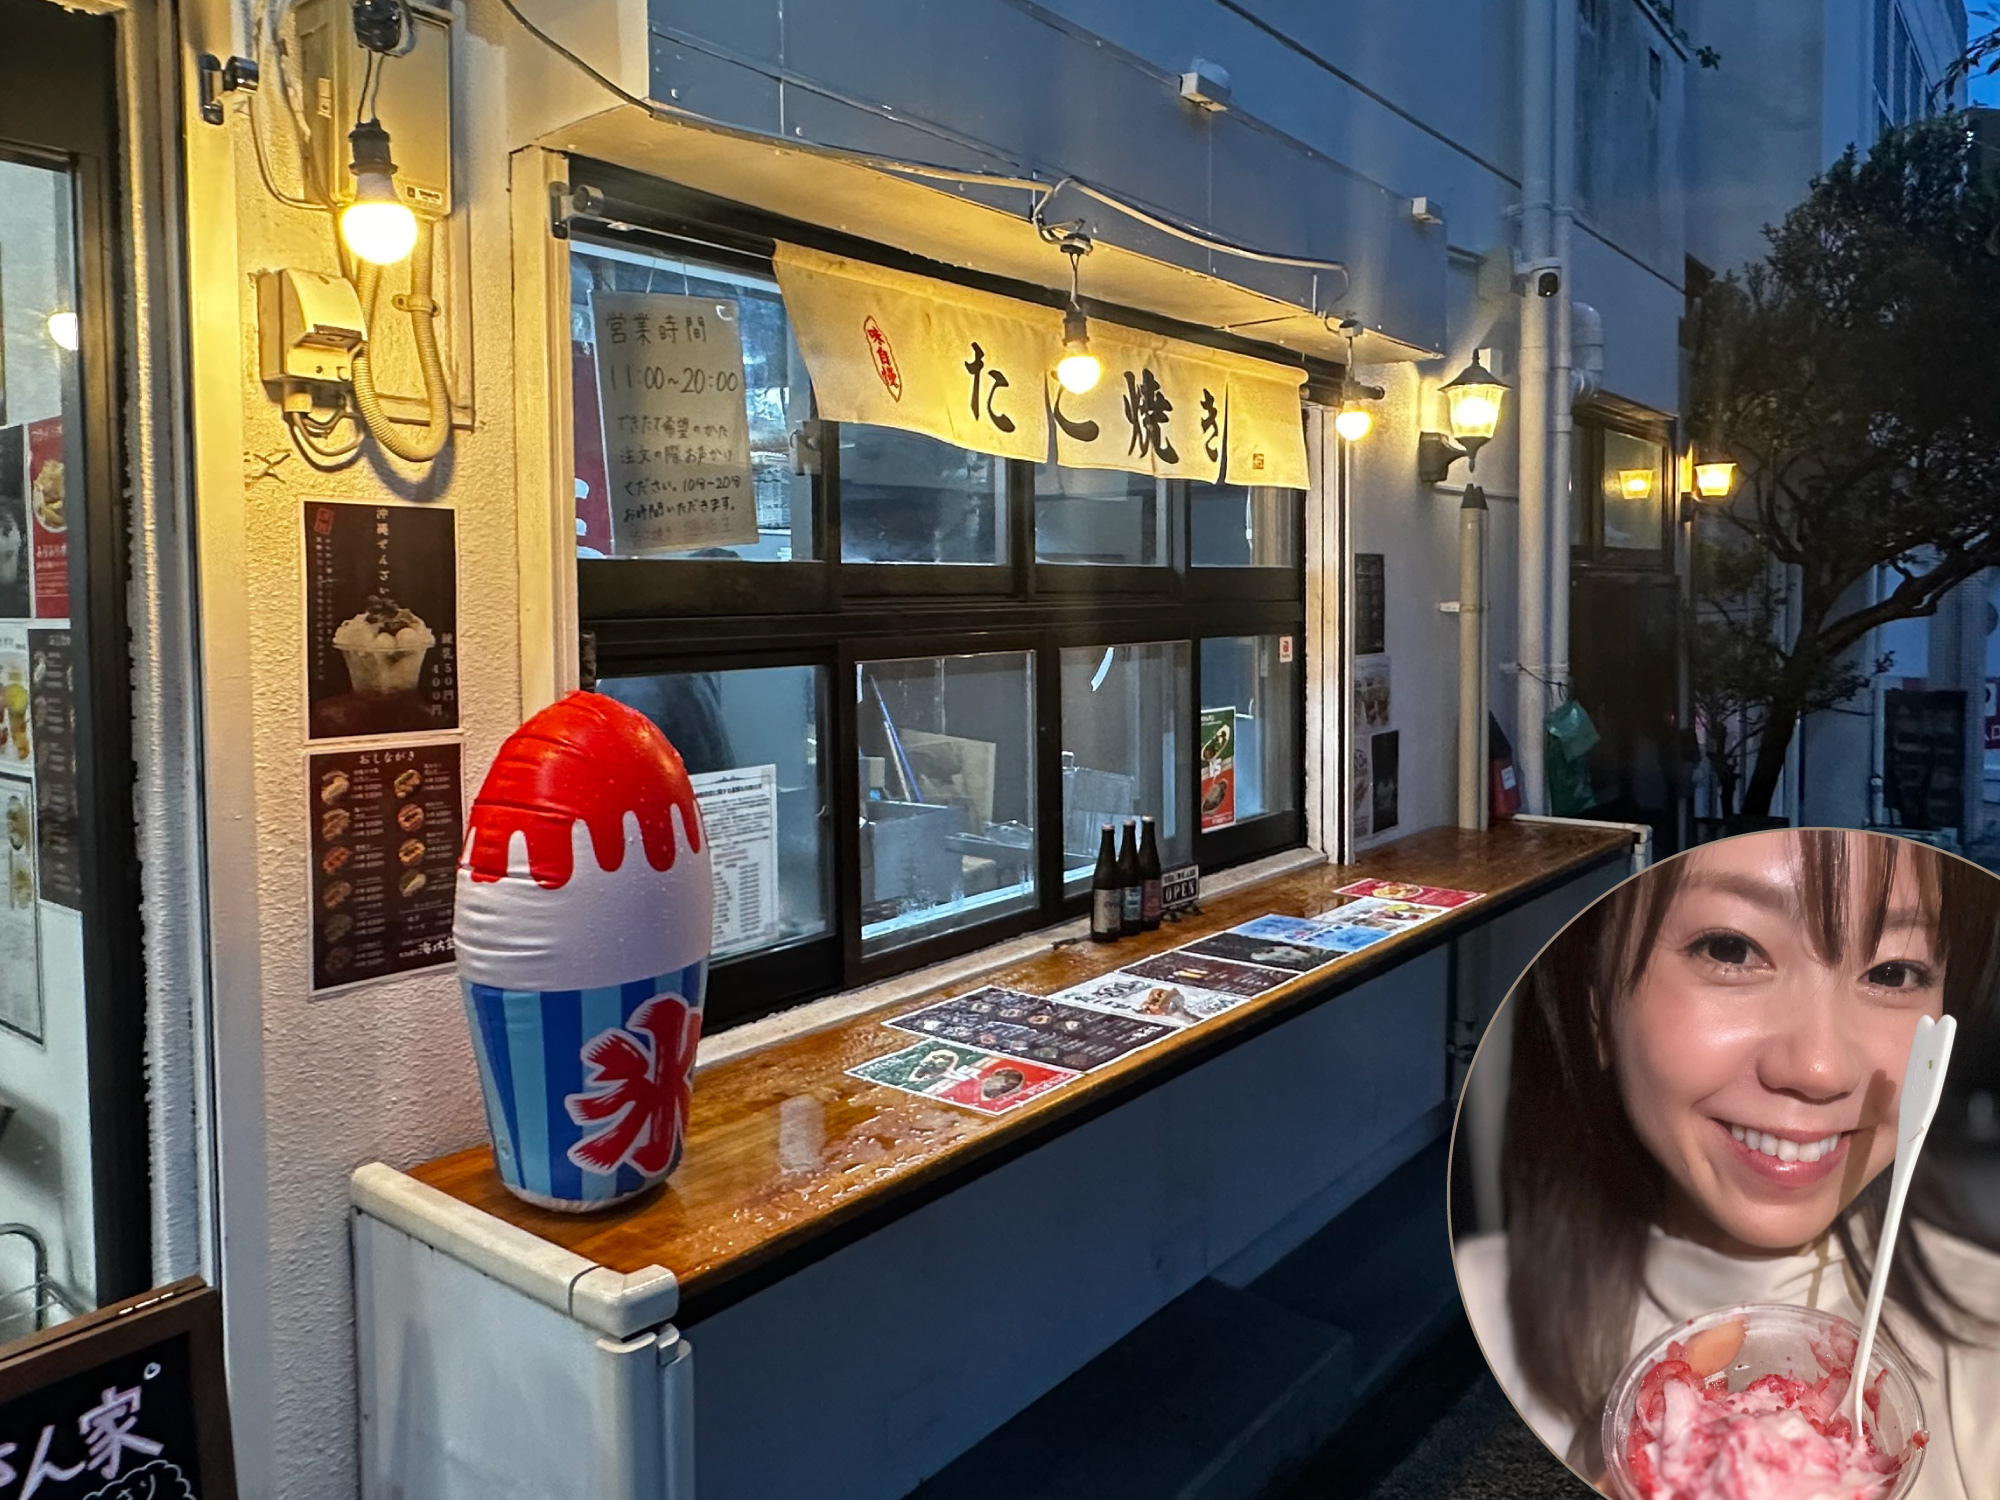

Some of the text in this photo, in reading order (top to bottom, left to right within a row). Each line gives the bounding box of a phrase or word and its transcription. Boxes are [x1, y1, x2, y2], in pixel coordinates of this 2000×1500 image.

[605, 312, 707, 345] 営業時間
[867, 326, 899, 389] 味自慢
[963, 341, 1221, 464] たこ焼き
[376, 507, 390, 595] 沖縄ぜんざい
[359, 751, 415, 765] おしながき
[1165, 880, 1196, 902] OPEN
